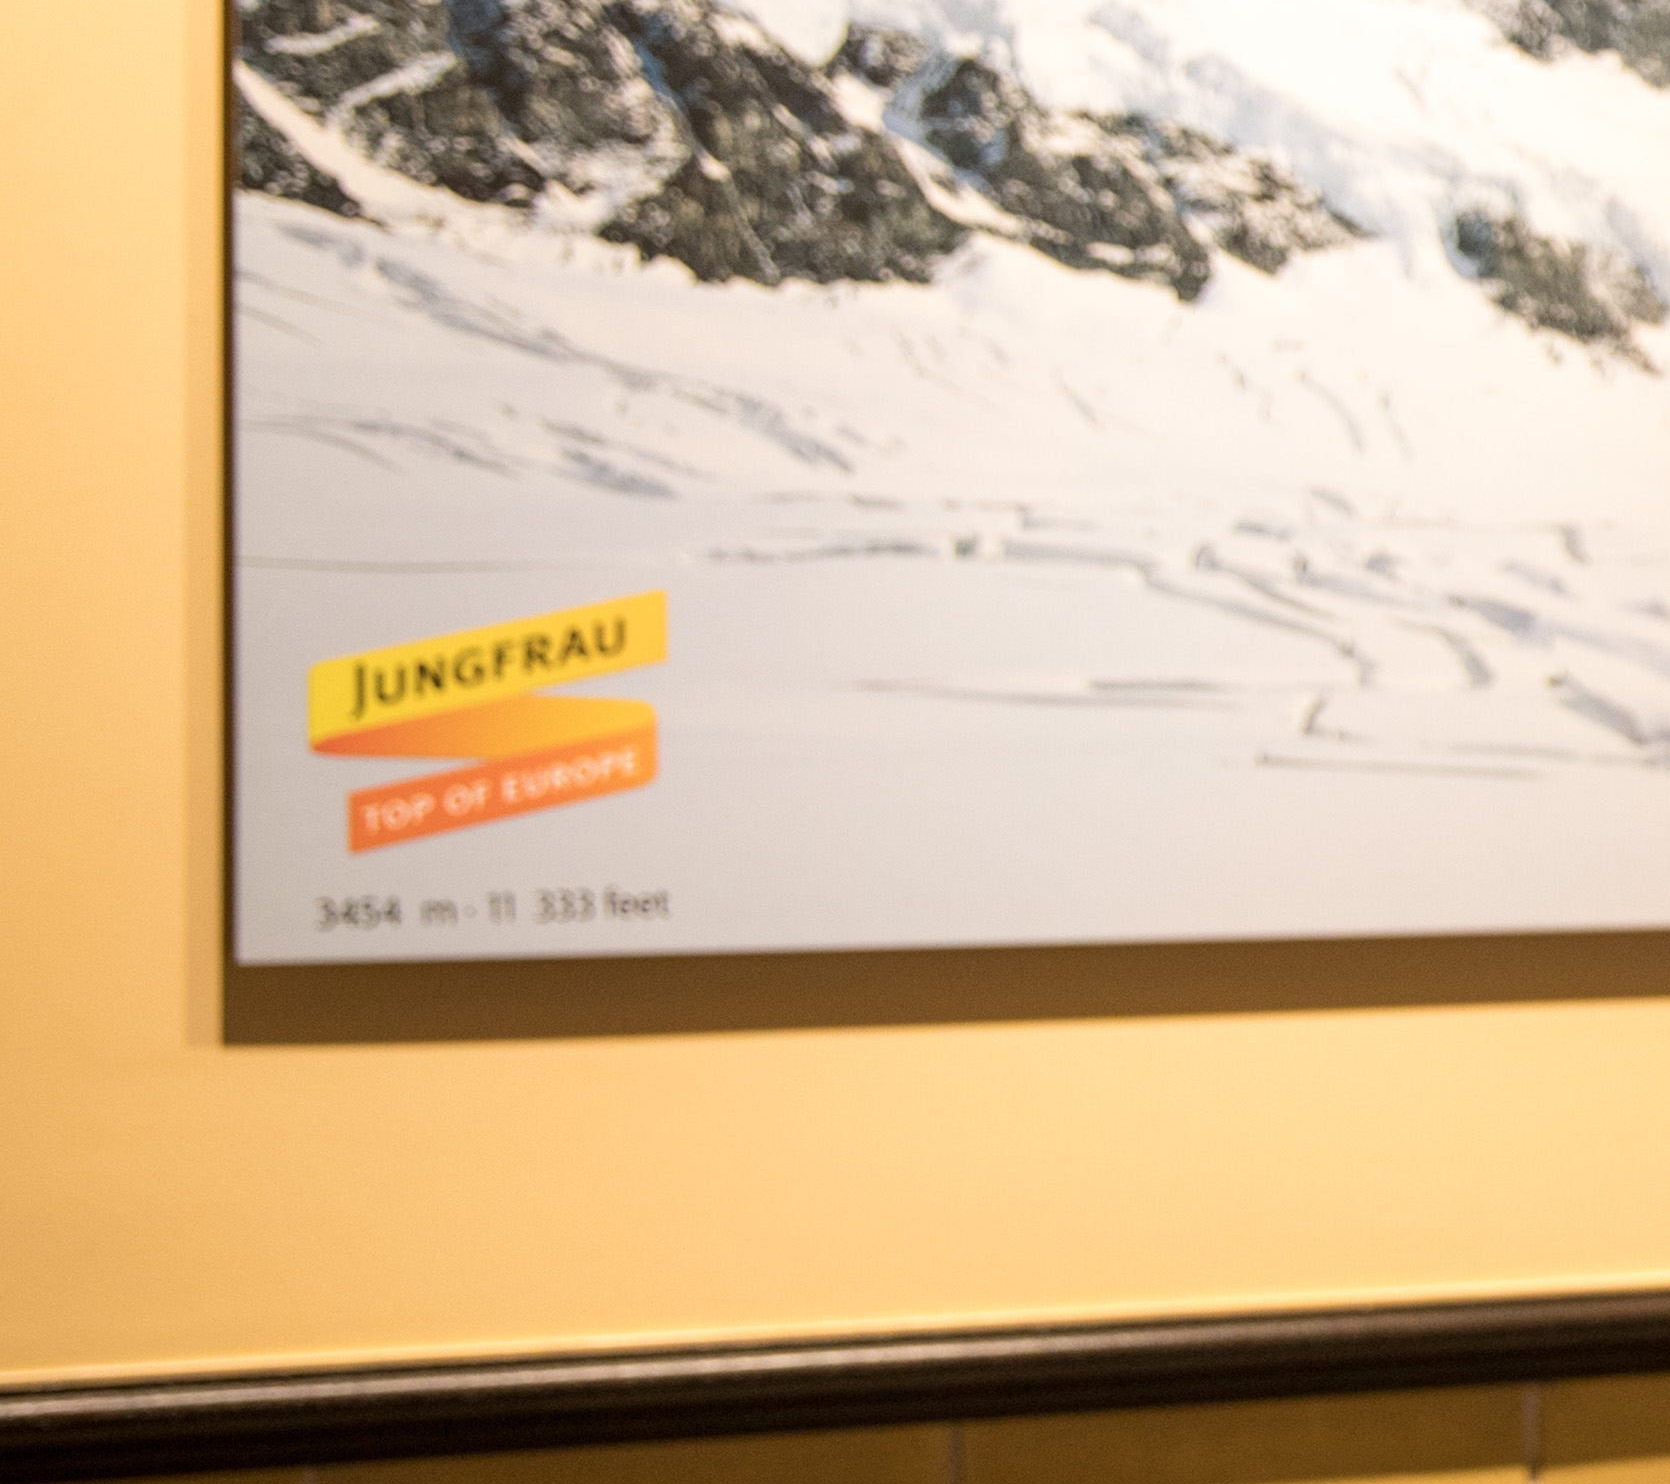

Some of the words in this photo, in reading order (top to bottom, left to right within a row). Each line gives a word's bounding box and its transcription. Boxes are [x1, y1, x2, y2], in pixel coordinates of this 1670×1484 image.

[350, 615, 628, 719] JUNGFRAU
[363, 791, 436, 835] TOP
[441, 777, 491, 818] OF
[501, 746, 638, 803] EUROPE
[314, 893, 403, 932] 3454
[419, 896, 458, 926] m
[532, 887, 597, 924] 333
[603, 882, 671, 917] feet
